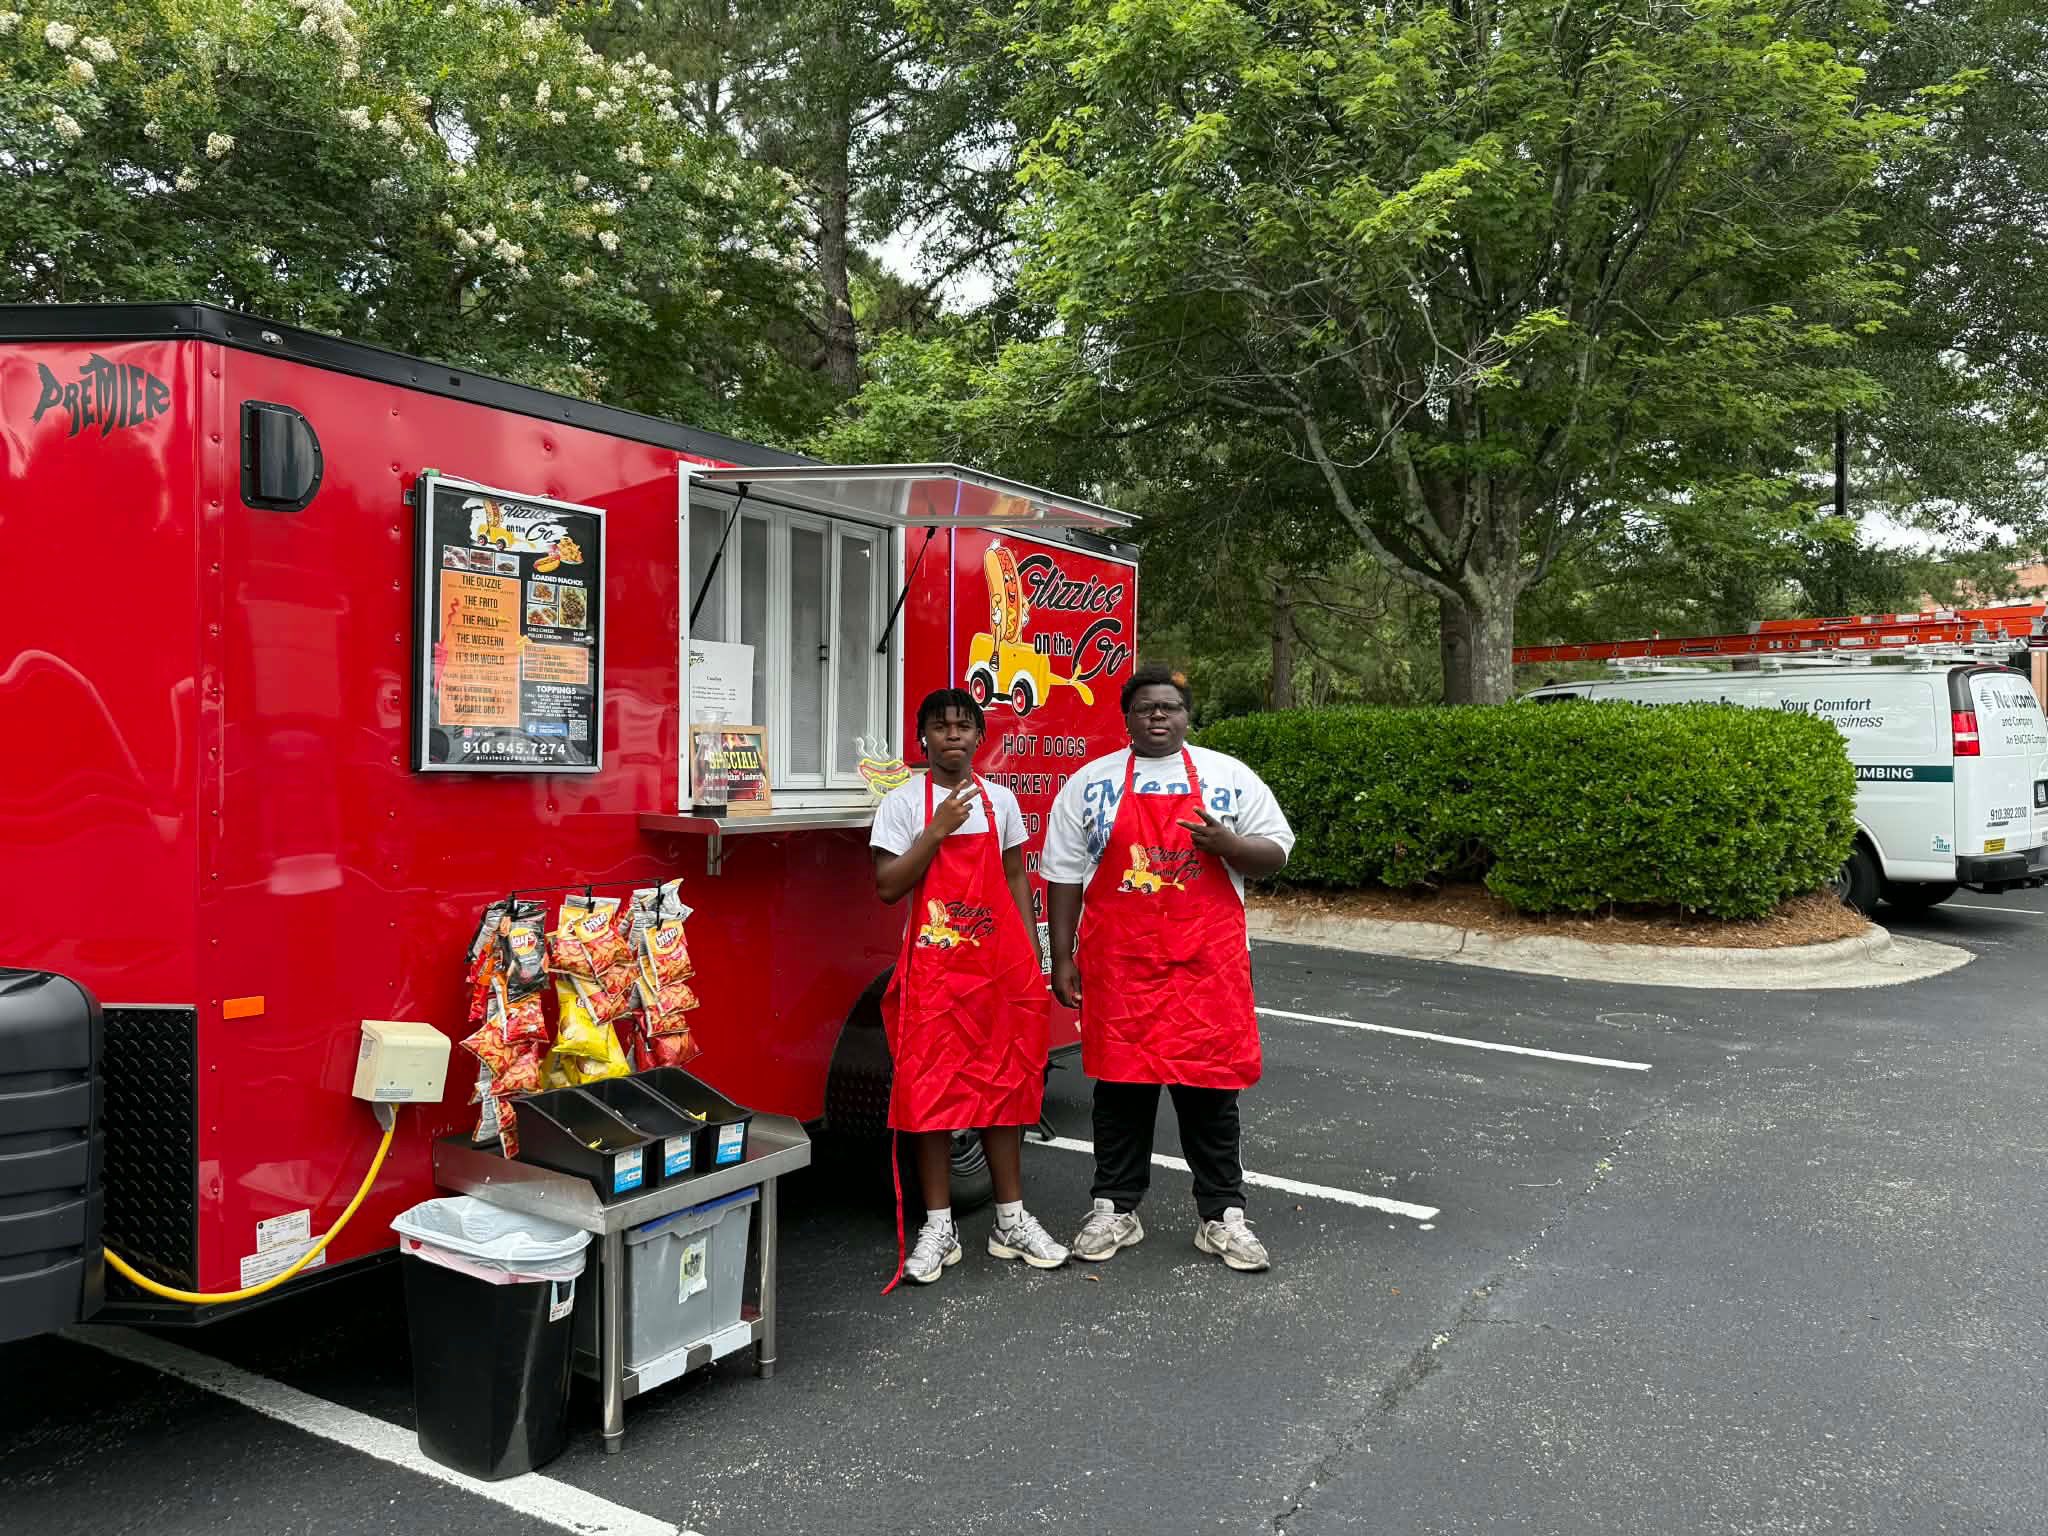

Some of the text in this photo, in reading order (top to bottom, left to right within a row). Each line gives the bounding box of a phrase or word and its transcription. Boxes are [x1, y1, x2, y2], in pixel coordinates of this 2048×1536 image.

[32, 353, 171, 438] PREMIER
[462, 575, 474, 586] THE
[1016, 553, 1123, 613] Glizzies
[464, 595, 478, 606] THE
[479, 597, 498, 609] FRITO
[462, 614, 499, 628] THE PHILLY
[457, 633, 504, 647] THE WESTERN
[1034, 617, 1131, 681] on the Go
[536, 686, 577, 694] TOPPINGS
[1781, 698, 1872, 712] Your Comfort
[463, 741, 566, 755] 910.945.7274
[1003, 734, 1086, 758] HOT DOGS
